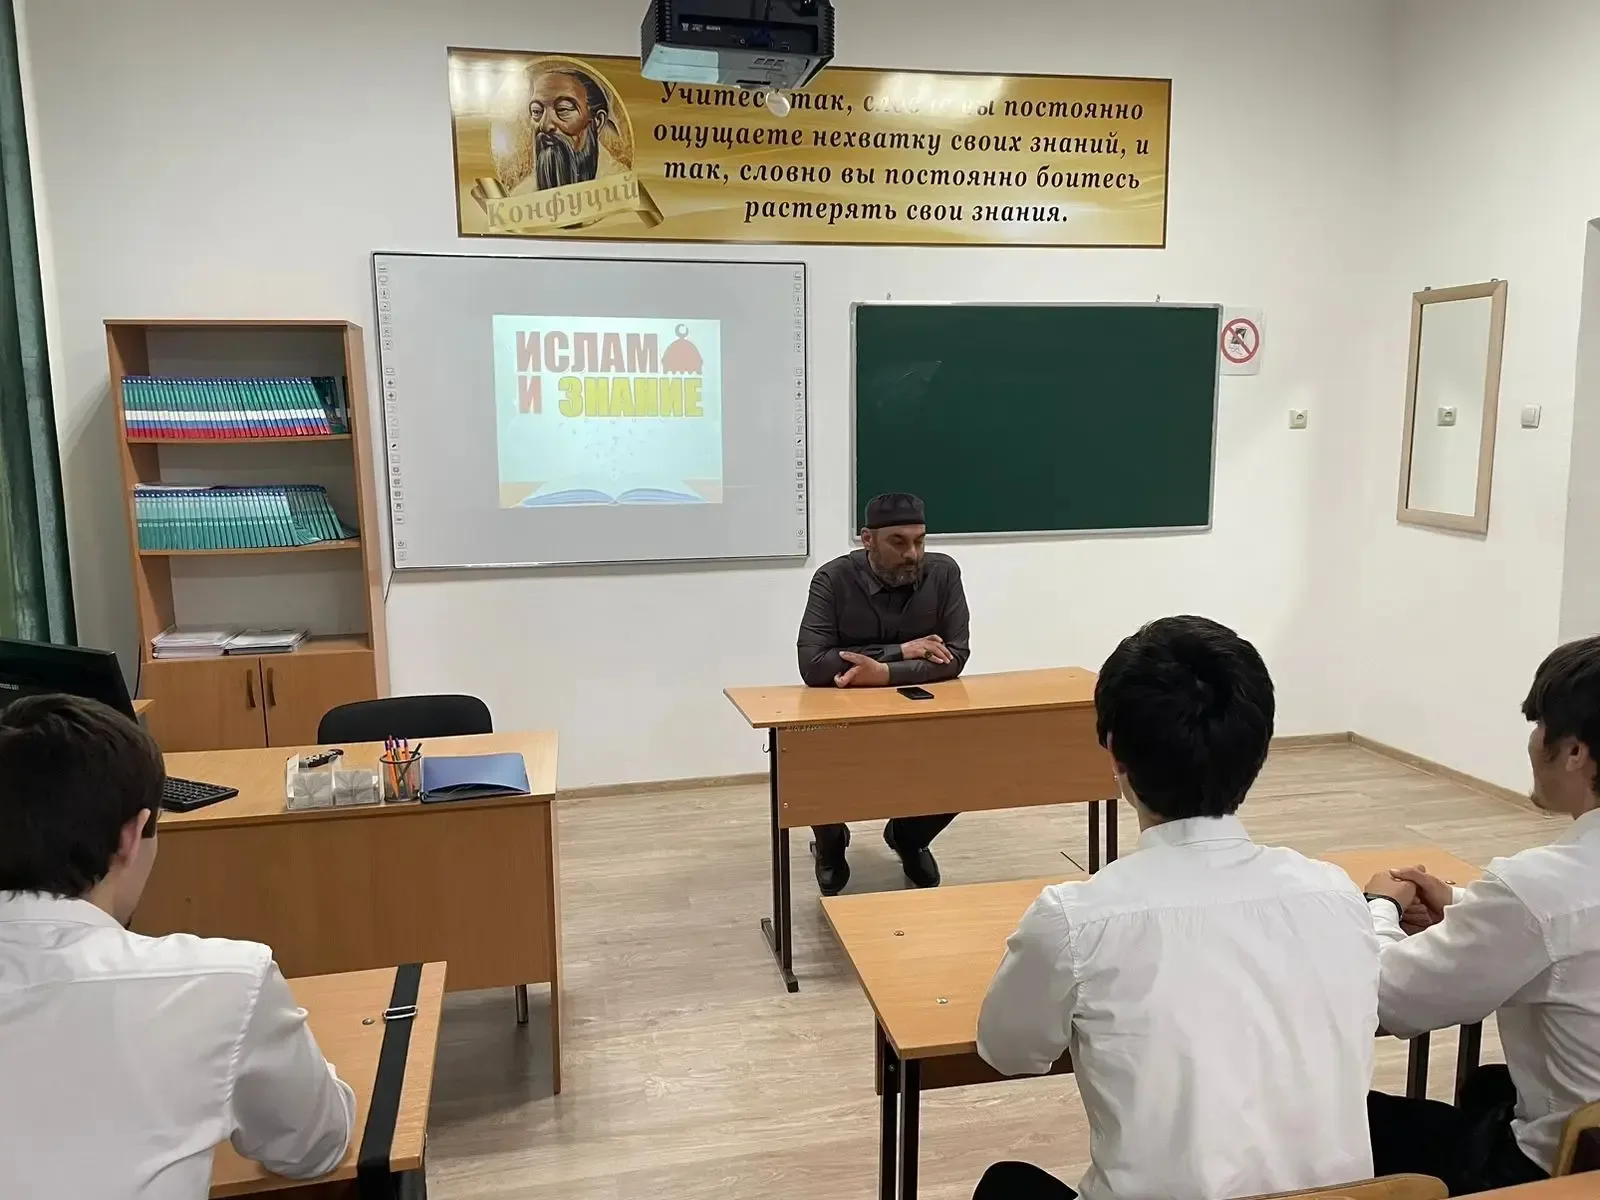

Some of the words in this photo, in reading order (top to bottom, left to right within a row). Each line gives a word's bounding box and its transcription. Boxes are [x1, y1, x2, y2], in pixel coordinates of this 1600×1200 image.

[661, 81, 766, 108] Учитес
[790, 93, 853, 116] так,
[1004, 99, 1144, 121] постоянно
[653, 123, 803, 150] ощущаете
[812, 128, 941, 156] нехватку
[951, 134, 1022, 152] своих
[1030, 131, 1127, 156] знаний,
[1136, 139, 1149, 155] и
[664, 161, 729, 185] так,
[740, 163, 831, 184] словно
[841, 167, 875, 185] вы
[885, 167, 1028, 189] постоянно
[1037, 164, 1140, 189] боитесь
[487, 172, 638, 228] Конфуций
[744, 200, 897, 225] растерять
[906, 204, 963, 222] свои
[972, 205, 1069, 223] знания.
[515, 330, 659, 374] ИСЛАМ
[518, 375, 543, 415] И
[558, 375, 705, 418] ЗНАНИЕ
